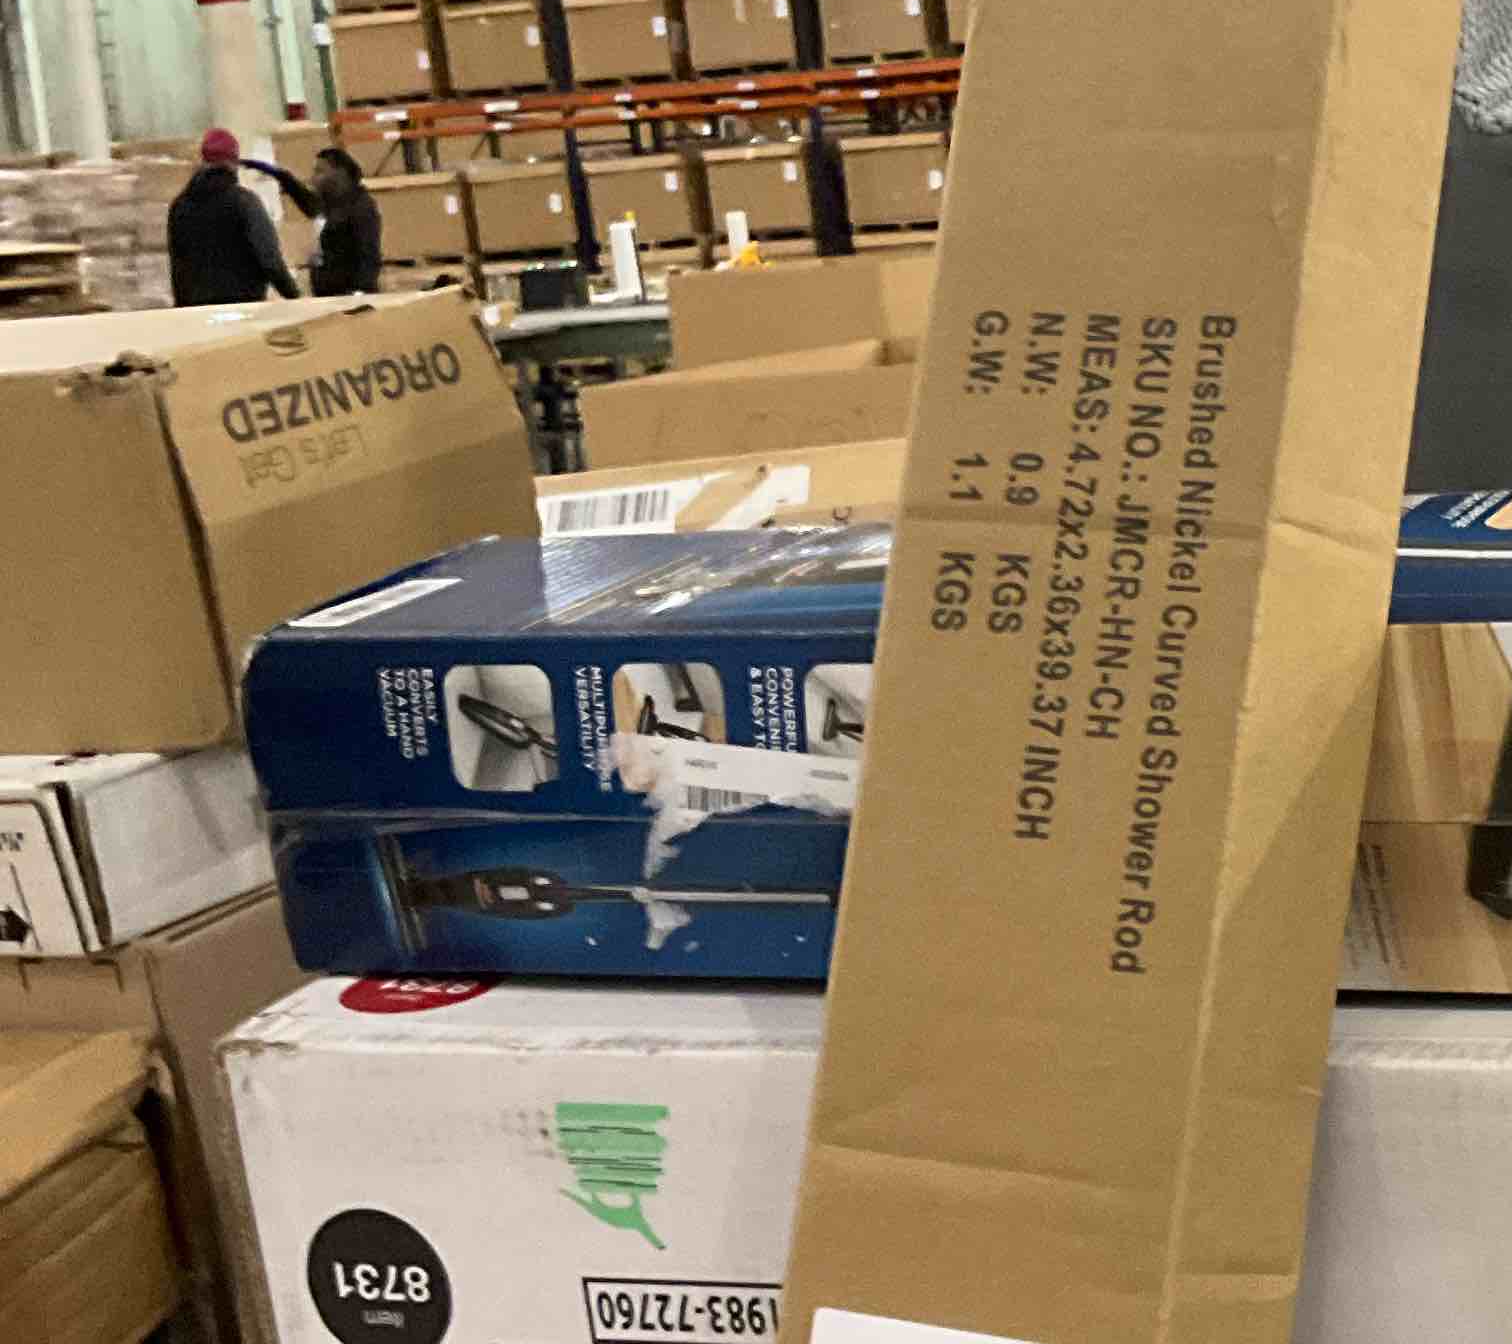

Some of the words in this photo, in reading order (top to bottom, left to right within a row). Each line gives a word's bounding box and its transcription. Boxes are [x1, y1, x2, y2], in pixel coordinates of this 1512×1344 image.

[221, 343, 461, 444] ORGANIZED
[964, 310, 1009, 394] G.W:
[1021, 312, 1067, 395] N.W:
[1134, 317, 1178, 394] SKU
[1184, 315, 1237, 469] Brushed
[949, 452, 989, 501] 1.1
[1005, 452, 1044, 506] 0.9
[1165, 480, 1215, 593] Nickel
[930, 552, 976, 632] KGS
[986, 553, 1031, 634] KGS
[1085, 493, 1150, 740] JMCR-HN-CH
[407, 667, 430, 756] CONVERTS
[420, 667, 438, 724] EASILY
[751, 682, 766, 729] EASY
[781, 667, 799, 752] POWERFU
[1146, 604, 1198, 737] Curved
[398, 712, 415, 759] HAND
[574, 667, 596, 771] VERSATILITY
[1014, 744, 1061, 840] INCH
[1124, 746, 1178, 890] Shower
[1110, 898, 1155, 974] Rod
[333, 1261, 431, 1303] 8731
